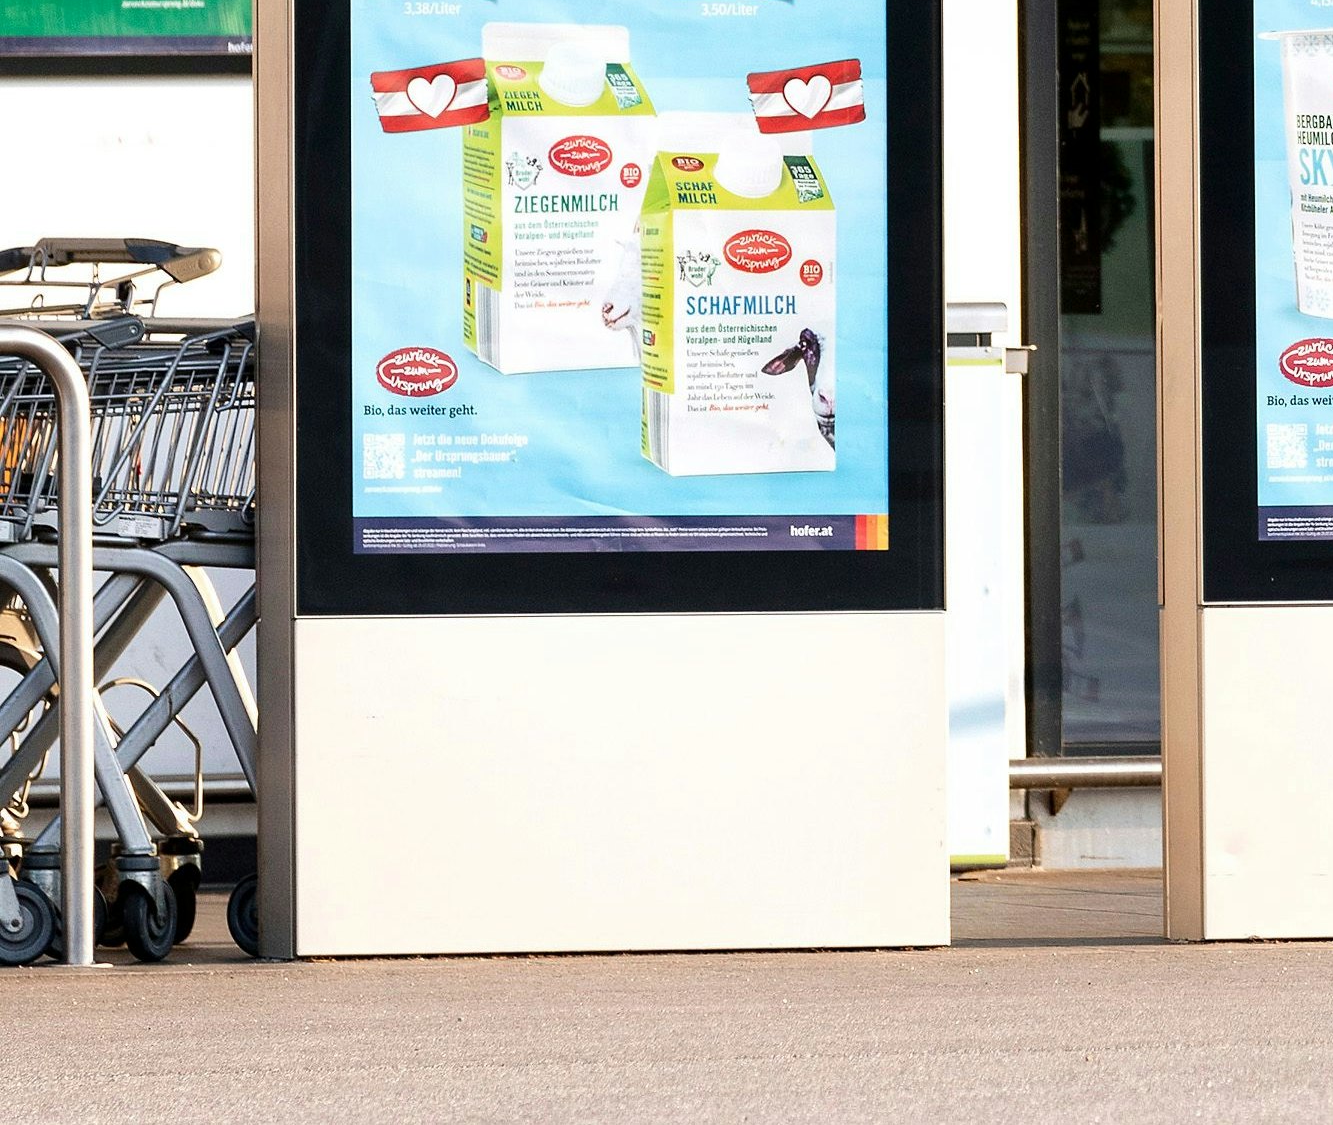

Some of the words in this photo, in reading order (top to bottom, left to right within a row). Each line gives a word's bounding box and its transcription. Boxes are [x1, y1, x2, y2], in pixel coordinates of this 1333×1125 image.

[503, 91, 540, 100] ZIEGEN
[506, 101, 544, 111] MILCH
[563, 138, 598, 150] zurück
[571, 151, 590, 159] zum
[559, 160, 600, 177] Ursprung
[623, 167, 640, 177] BIO
[676, 181, 714, 191] SCHAF
[513, 193, 619, 214] ZIEGENMILCH
[678, 193, 717, 204] MILCH
[739, 232, 777, 245] zurück
[746, 247, 767, 255] zum
[735, 255, 780, 273] Ursprung
[802, 265, 820, 274] BIO
[686, 295, 796, 315] SCHAFMILCH
[686, 325, 699, 333] aus
[701, 324, 716, 333] dem
[394, 349, 441, 367] zurück
[1306, 357, 1331, 366] zum
[404, 366, 430, 376] zum
[390, 376, 444, 396] Ursprung
[1267, 395, 1288, 408] Bio,
[1290, 395, 1309, 406] das
[363, 405, 385, 418] Bio,
[387, 404, 407, 416] das
[409, 405, 446, 416] weiter
[449, 405, 478, 419] geht.
[790, 525, 834, 537] hofer.at
